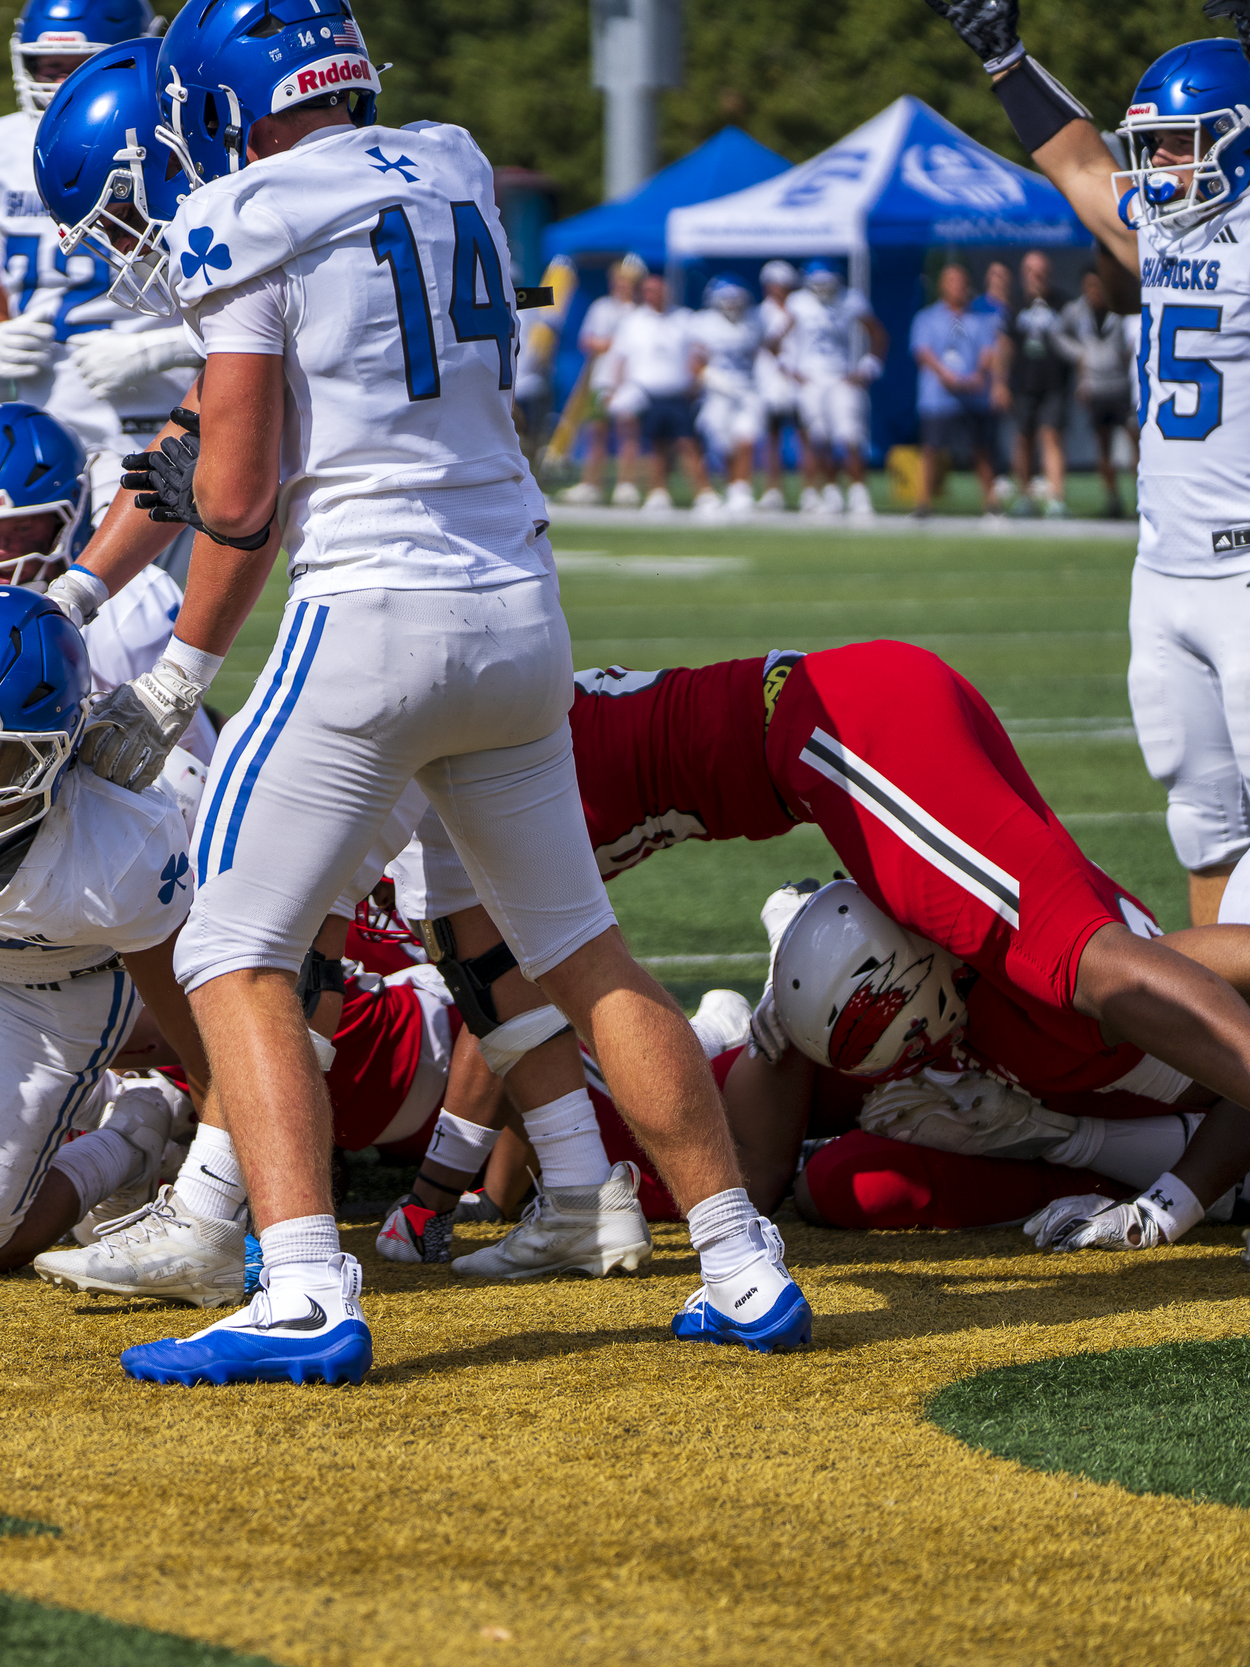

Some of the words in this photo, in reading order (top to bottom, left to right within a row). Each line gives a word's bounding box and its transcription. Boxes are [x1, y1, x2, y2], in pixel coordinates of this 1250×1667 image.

[298, 30, 316, 47] 14
[297, 59, 372, 95] Riddell
[370, 201, 516, 402] 14
[155, 1260, 195, 1281] ALPHA
[734, 1287, 759, 1310] ALPHA
